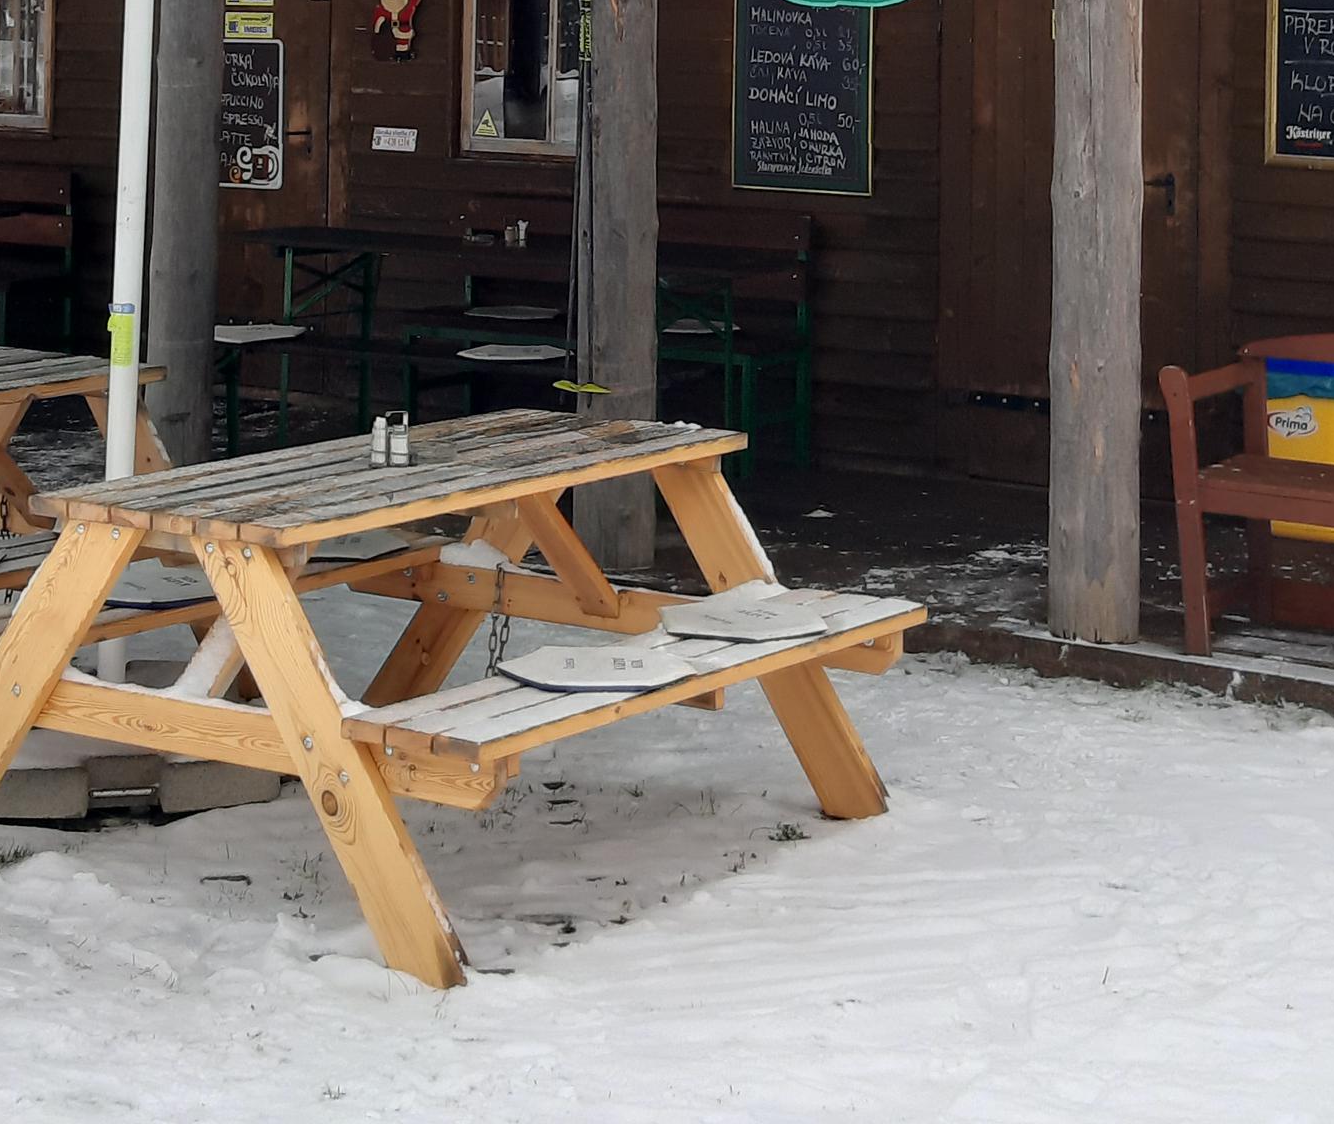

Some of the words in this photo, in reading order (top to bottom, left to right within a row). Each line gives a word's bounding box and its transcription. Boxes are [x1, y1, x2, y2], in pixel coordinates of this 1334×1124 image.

[223, 49, 255, 70] ORKÁ
[750, 44, 797, 65] LEDOVÁ
[805, 91, 838, 111] LIMO
[222, 113, 264, 127] SPRESSO
[1297, 103, 1323, 123] NA
[220, 130, 253, 147] ATTE
[1274, 416, 1308, 430] Prima
